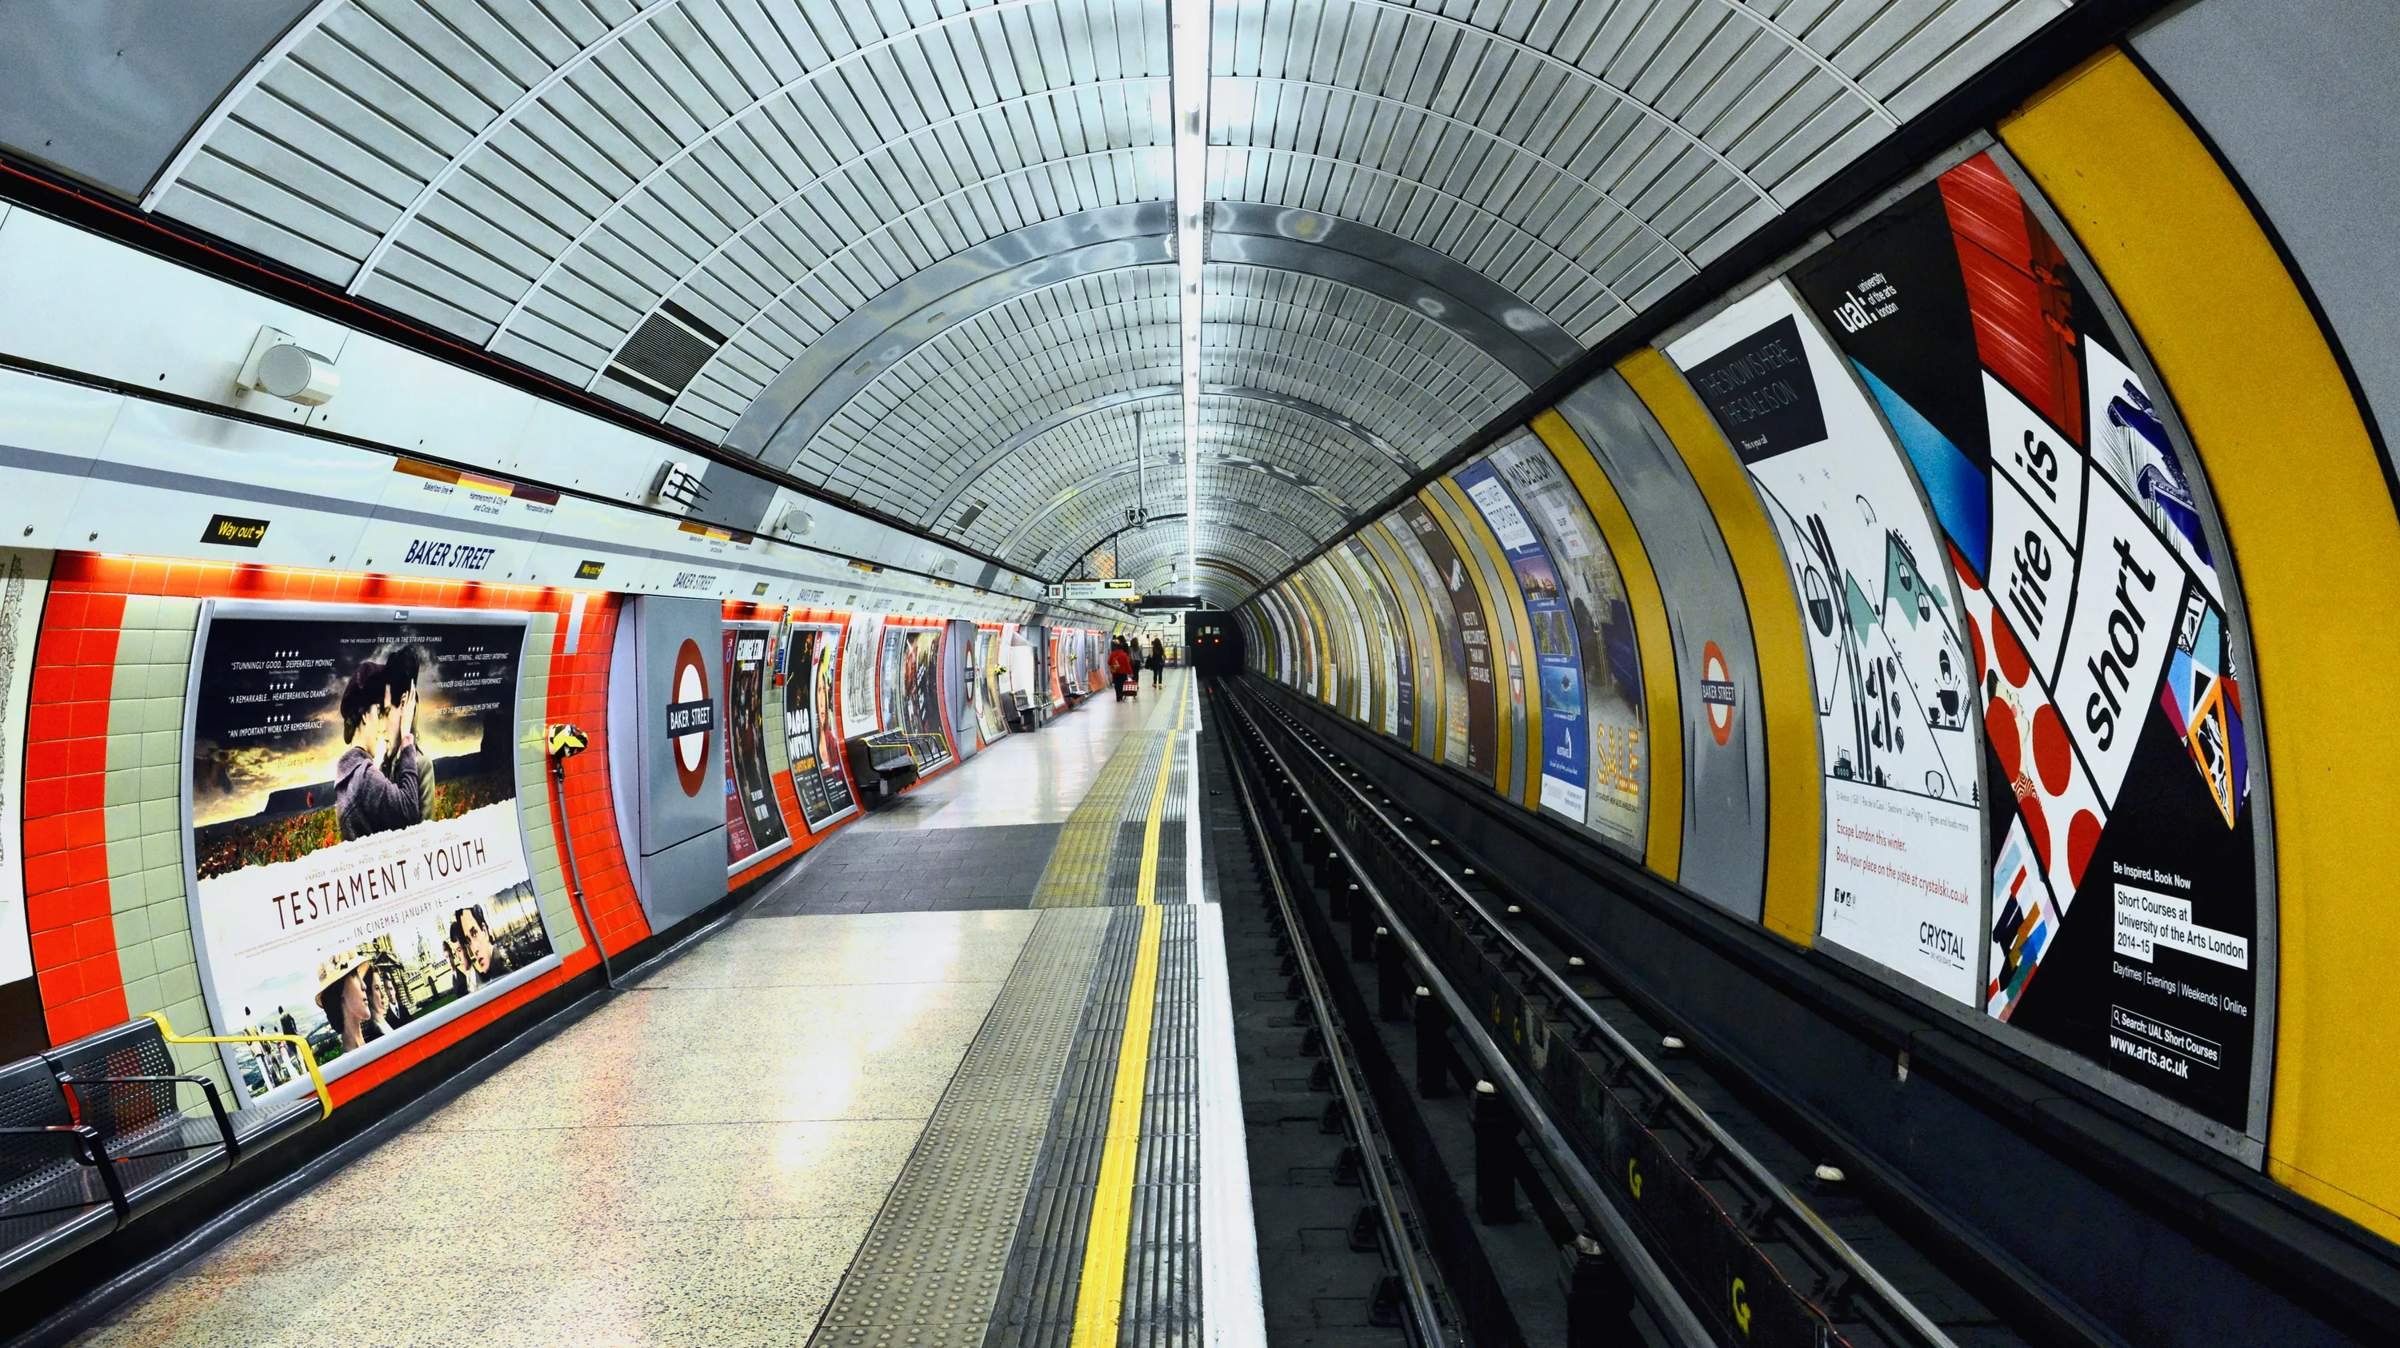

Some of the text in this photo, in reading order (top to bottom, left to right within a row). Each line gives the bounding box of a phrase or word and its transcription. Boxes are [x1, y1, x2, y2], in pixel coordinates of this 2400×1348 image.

[1857, 273, 1887, 292] university
[1868, 285, 1897, 305] of the arts
[1833, 291, 1878, 333] ual:
[1875, 303, 1899, 318] london
[218, 521, 255, 540] Way out
[2008, 429, 2058, 642] life is
[404, 539, 496, 570] BAKER STREET
[2086, 536, 2156, 752] short
[1702, 684, 1734, 701] BAKER STREET
[268, 724, 282, 733] WORK
[283, 724, 290, 732] OF
[670, 706, 710, 730] BAKER STREET
[1836, 818, 1854, 841] Escape
[1855, 824, 1875, 842] London
[1876, 829, 1887, 846] this
[272, 860, 407, 930] TESTAMENT
[424, 838, 487, 881] YOUTH
[1836, 846, 1850, 864] Book
[1850, 856, 1862, 871] your
[1863, 856, 1877, 876] place
[1878, 864, 1885, 875] on
[1886, 863, 1897, 880] the
[1911, 874, 1919, 887] at
[1919, 878, 1969, 905] crystalski.co.uk
[2113, 861, 2191, 889] Be Inspired. Book Now
[2118, 891, 2188, 921] Short Courses at
[1919, 921, 1965, 961] CRYSTAL
[2118, 911, 2244, 959] University of the Arts London
[2113, 961, 2248, 1017] Daytimes Evenings Weekends Online
[2121, 1013, 2218, 1061] Search: UAL Short Courses
[2110, 1034, 2189, 1079] www.arts.ac.uk
